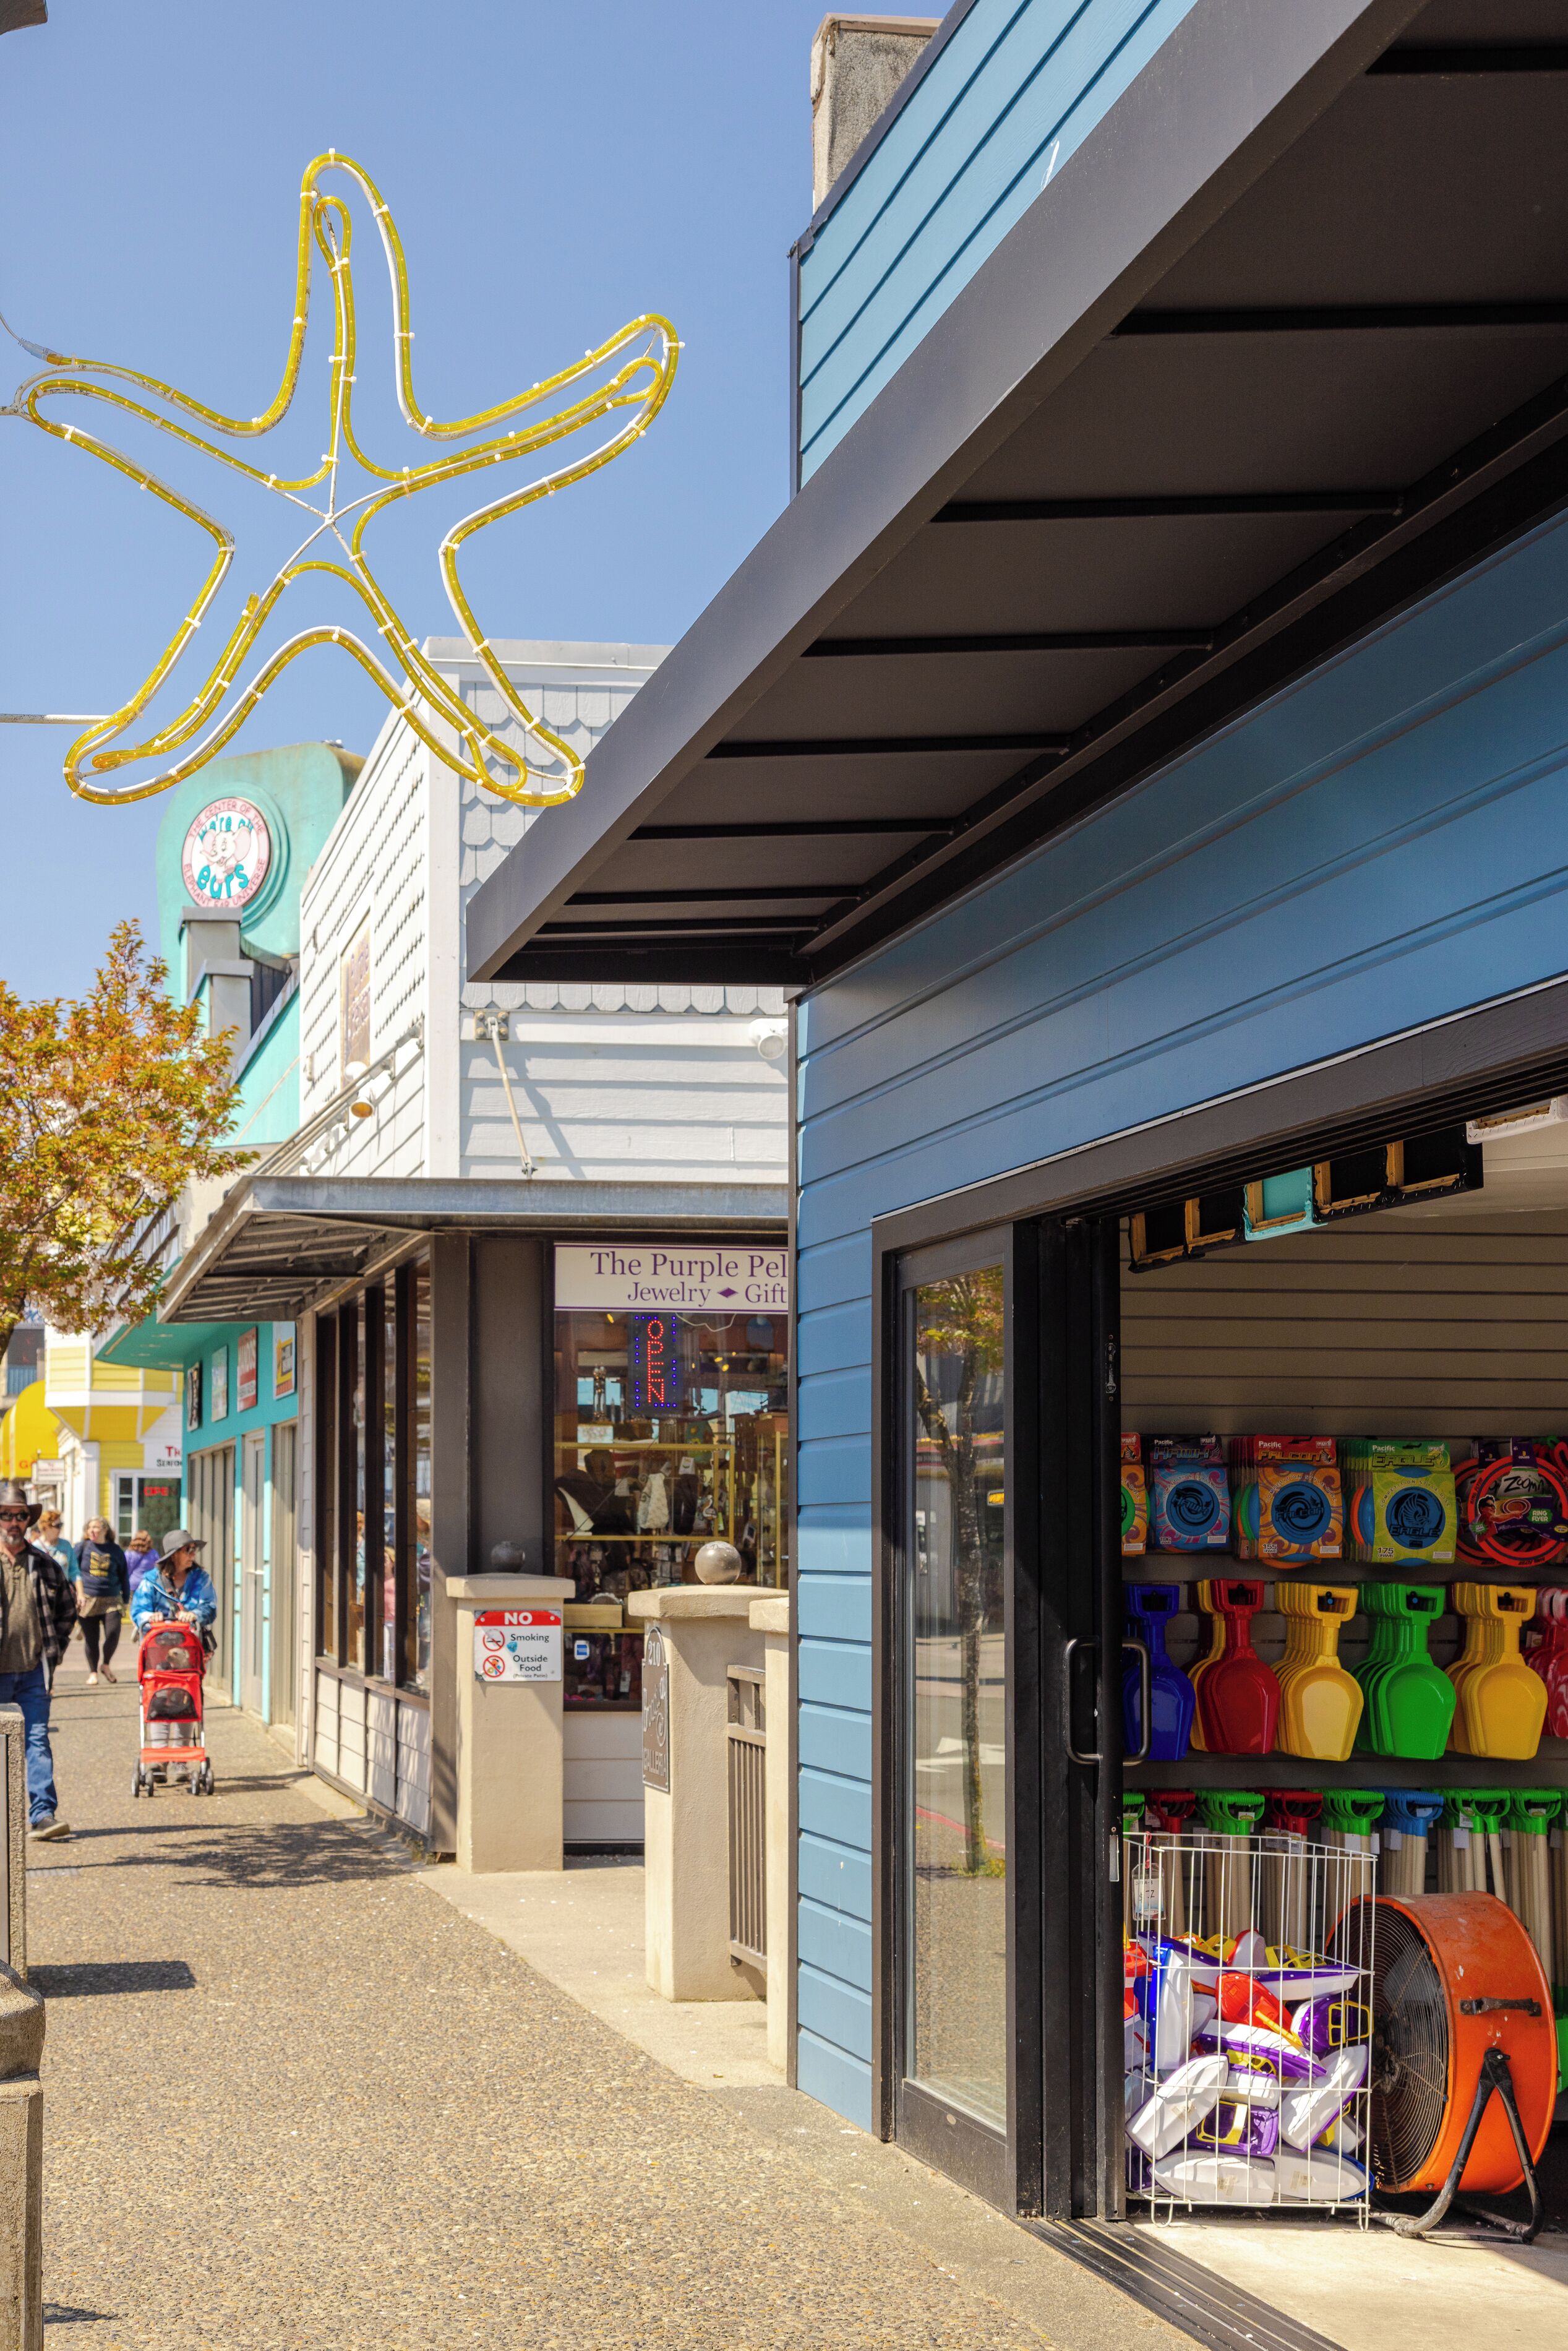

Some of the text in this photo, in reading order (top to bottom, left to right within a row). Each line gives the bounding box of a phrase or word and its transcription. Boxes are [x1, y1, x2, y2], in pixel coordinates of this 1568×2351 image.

[187, 800, 264, 838] THE CENTER OF THE
[183, 864, 211, 906] ELEPHANT
[233, 858, 265, 905] UNIVERSE
[590, 1251, 641, 1275] The
[651, 1253, 739, 1283] Purple
[627, 1281, 787, 1307] Jewelry Gift
[647, 1320, 664, 1404] OPEN
[1154, 1446, 1211, 1460] HAWK
[1257, 1449, 1321, 1462] FALCON
[1372, 1453, 1436, 1468] EAGLE
[1266, 1475, 1302, 1503] COMPETITION
[1380, 1480, 1451, 1509] COMPETITION STYLE DISC
[1275, 1507, 1324, 1522] FALCON
[1389, 1524, 1441, 1537] EAGLE
[504, 1612, 533, 1625] NO
[510, 1634, 549, 1643] Smoking
[648, 1641, 661, 1667] 210
[643, 1747, 666, 1777] GALLERIA
